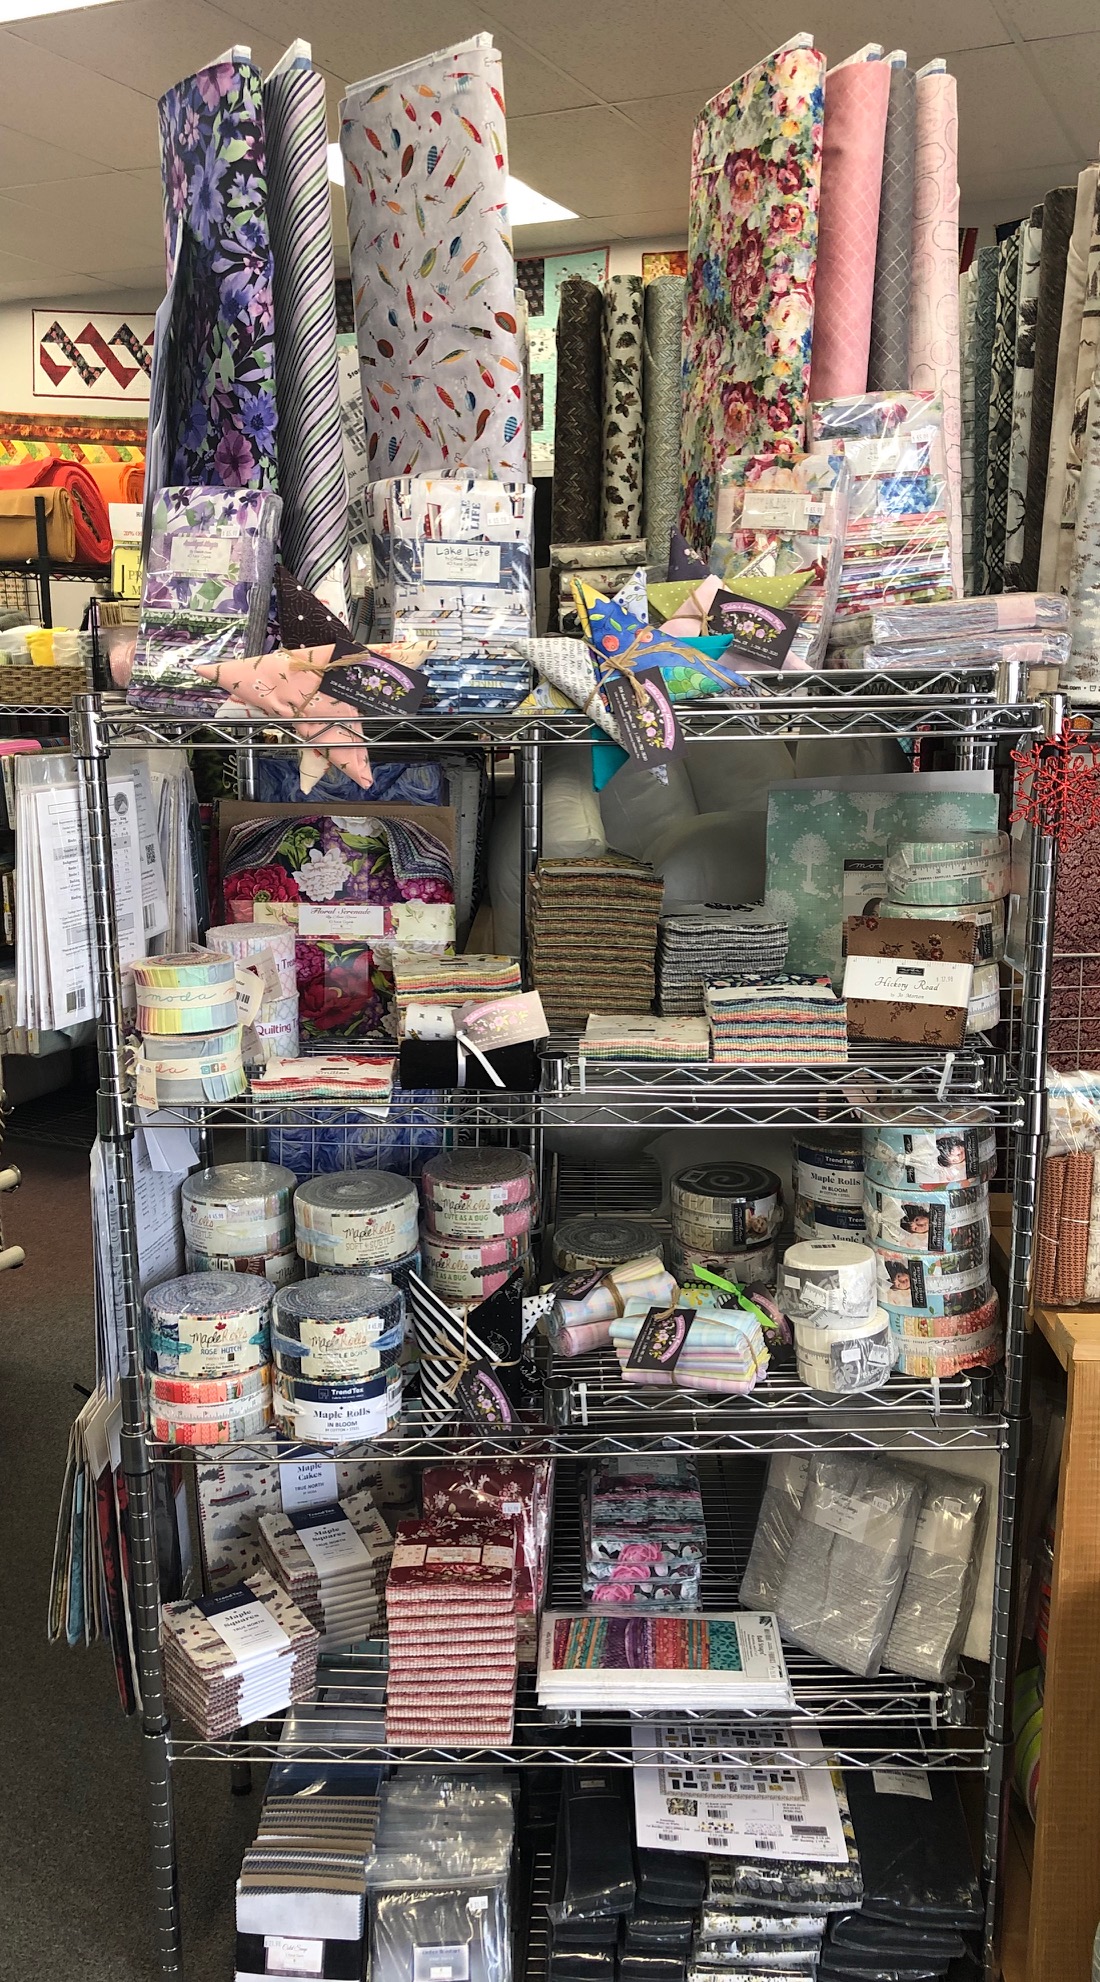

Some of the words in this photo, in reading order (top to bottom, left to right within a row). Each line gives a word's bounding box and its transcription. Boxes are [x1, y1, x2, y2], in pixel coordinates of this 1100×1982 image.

[471, 502, 481, 530] LIFE
[436, 546, 462, 556] Lake
[467, 546, 490, 557] Life
[310, 907, 336, 915] Floral
[338, 907, 371, 915] Serenade
[874, 976, 909, 991] Hickory
[913, 979, 940, 991] Road
[147, 991, 217, 1002] moda
[256, 1023, 292, 1036] Quilting
[825, 1156, 855, 1165] TrendTex
[810, 1172, 835, 1184] Maple
[837, 1177, 861, 1186] Rolls
[369, 1236, 395, 1249] SUBTLE
[832, 1233, 859, 1243] Maple
[221, 1345, 242, 1353] HUTCH
[331, 1387, 364, 1396] TrendTex
[313, 1410, 343, 1420] Maple
[347, 1408, 371, 1418] Rolls
[297, 1463, 323, 1473] Maple
[298, 1472, 323, 1481] Cakes
[312, 1532, 347, 1542] Squares
[314, 1527, 340, 1537] Maple
[223, 1614, 260, 1627] Squares
[224, 1609, 252, 1621] Maple
